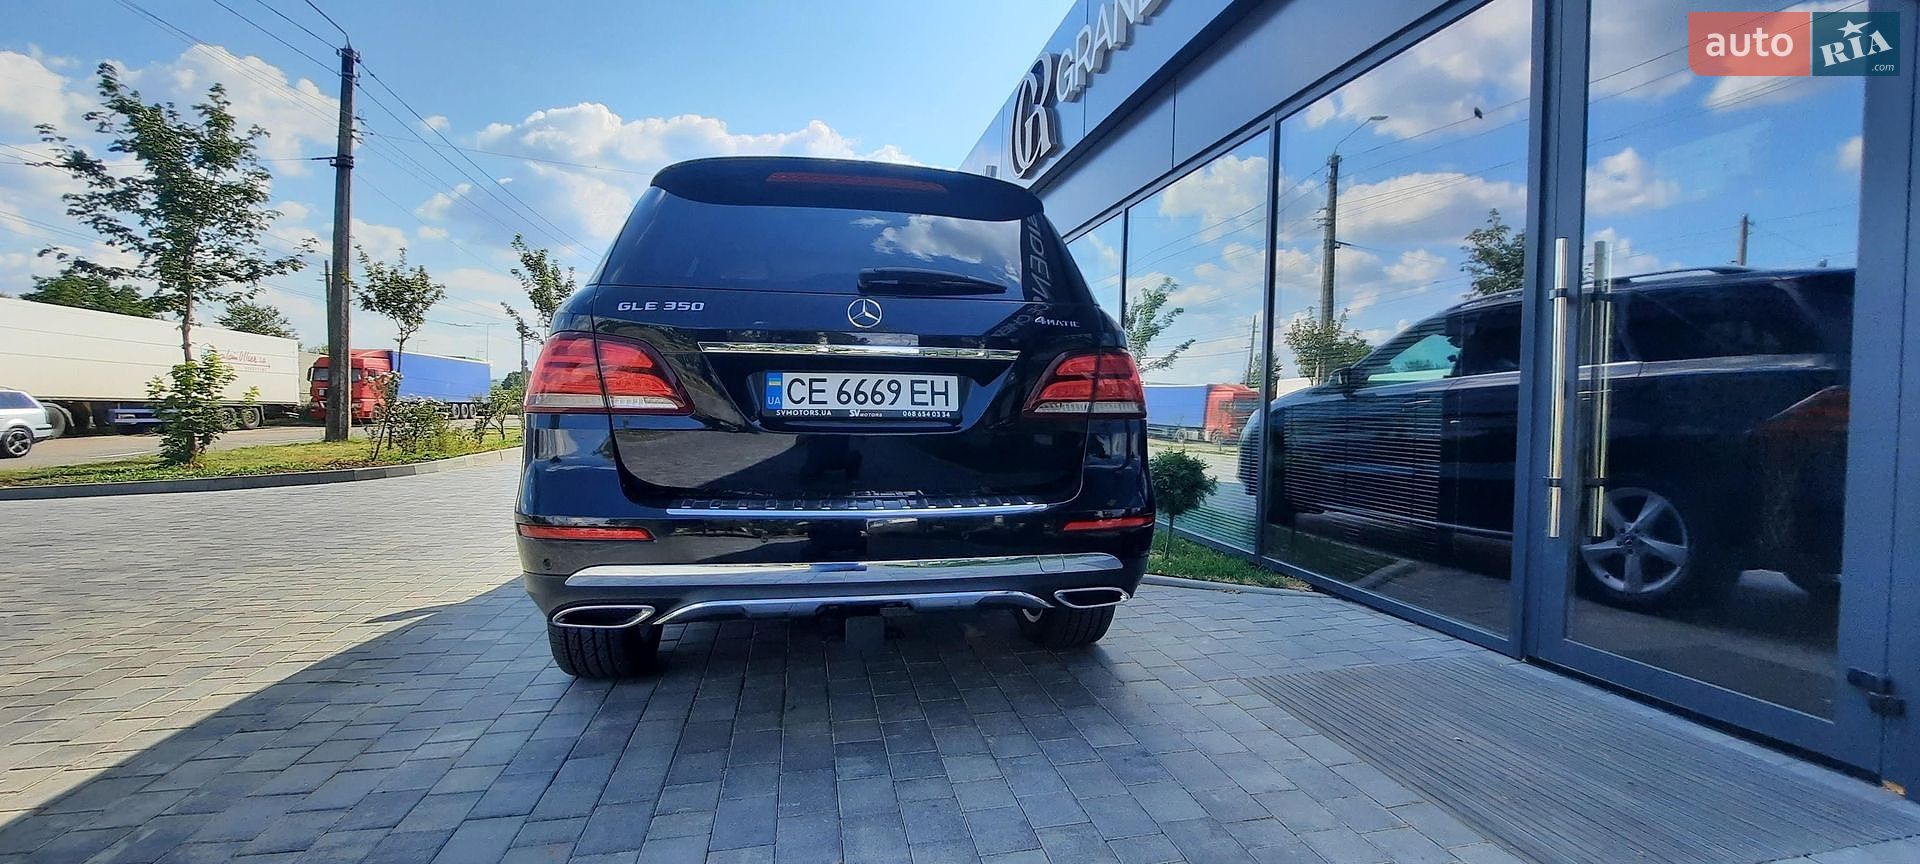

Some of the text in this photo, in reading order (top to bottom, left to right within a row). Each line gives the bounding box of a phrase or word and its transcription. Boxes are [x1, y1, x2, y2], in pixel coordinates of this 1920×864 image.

[617, 301, 705, 311] GLE 350
[1034, 315, 1081, 328] 4MATIC
[786, 377, 950, 407] CE 6669 EH
[767, 396, 781, 405] UA
